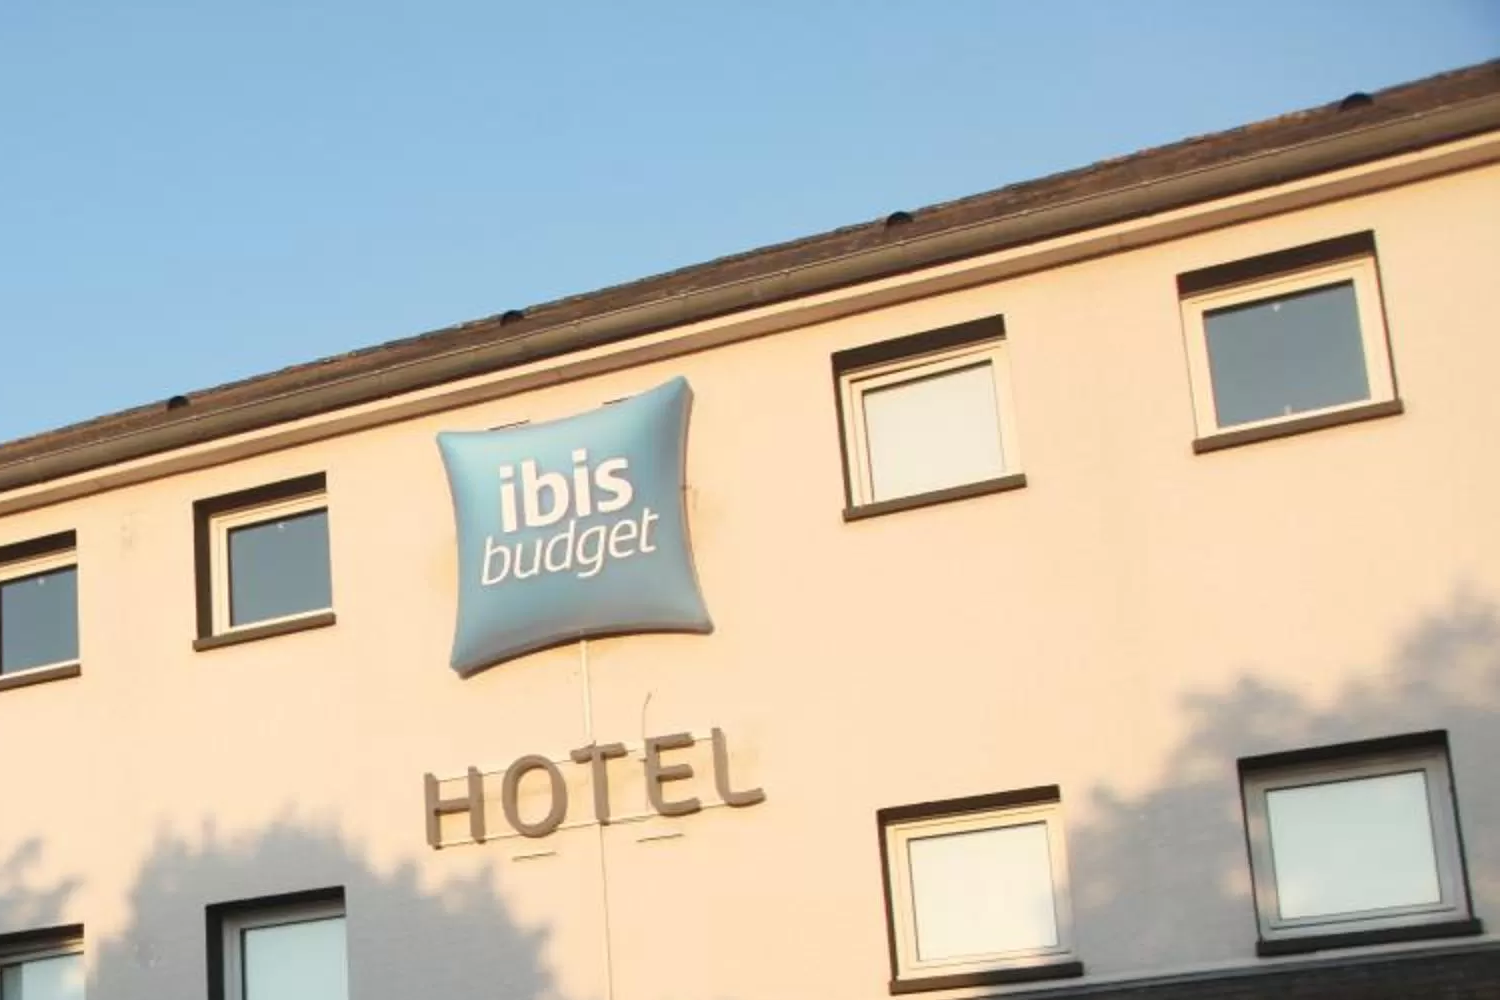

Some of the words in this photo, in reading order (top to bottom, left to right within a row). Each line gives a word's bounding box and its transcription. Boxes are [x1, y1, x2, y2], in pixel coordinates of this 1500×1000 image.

[499, 447, 634, 534] ibis
[481, 506, 661, 587] budget
[424, 726, 767, 850] HOTEL
